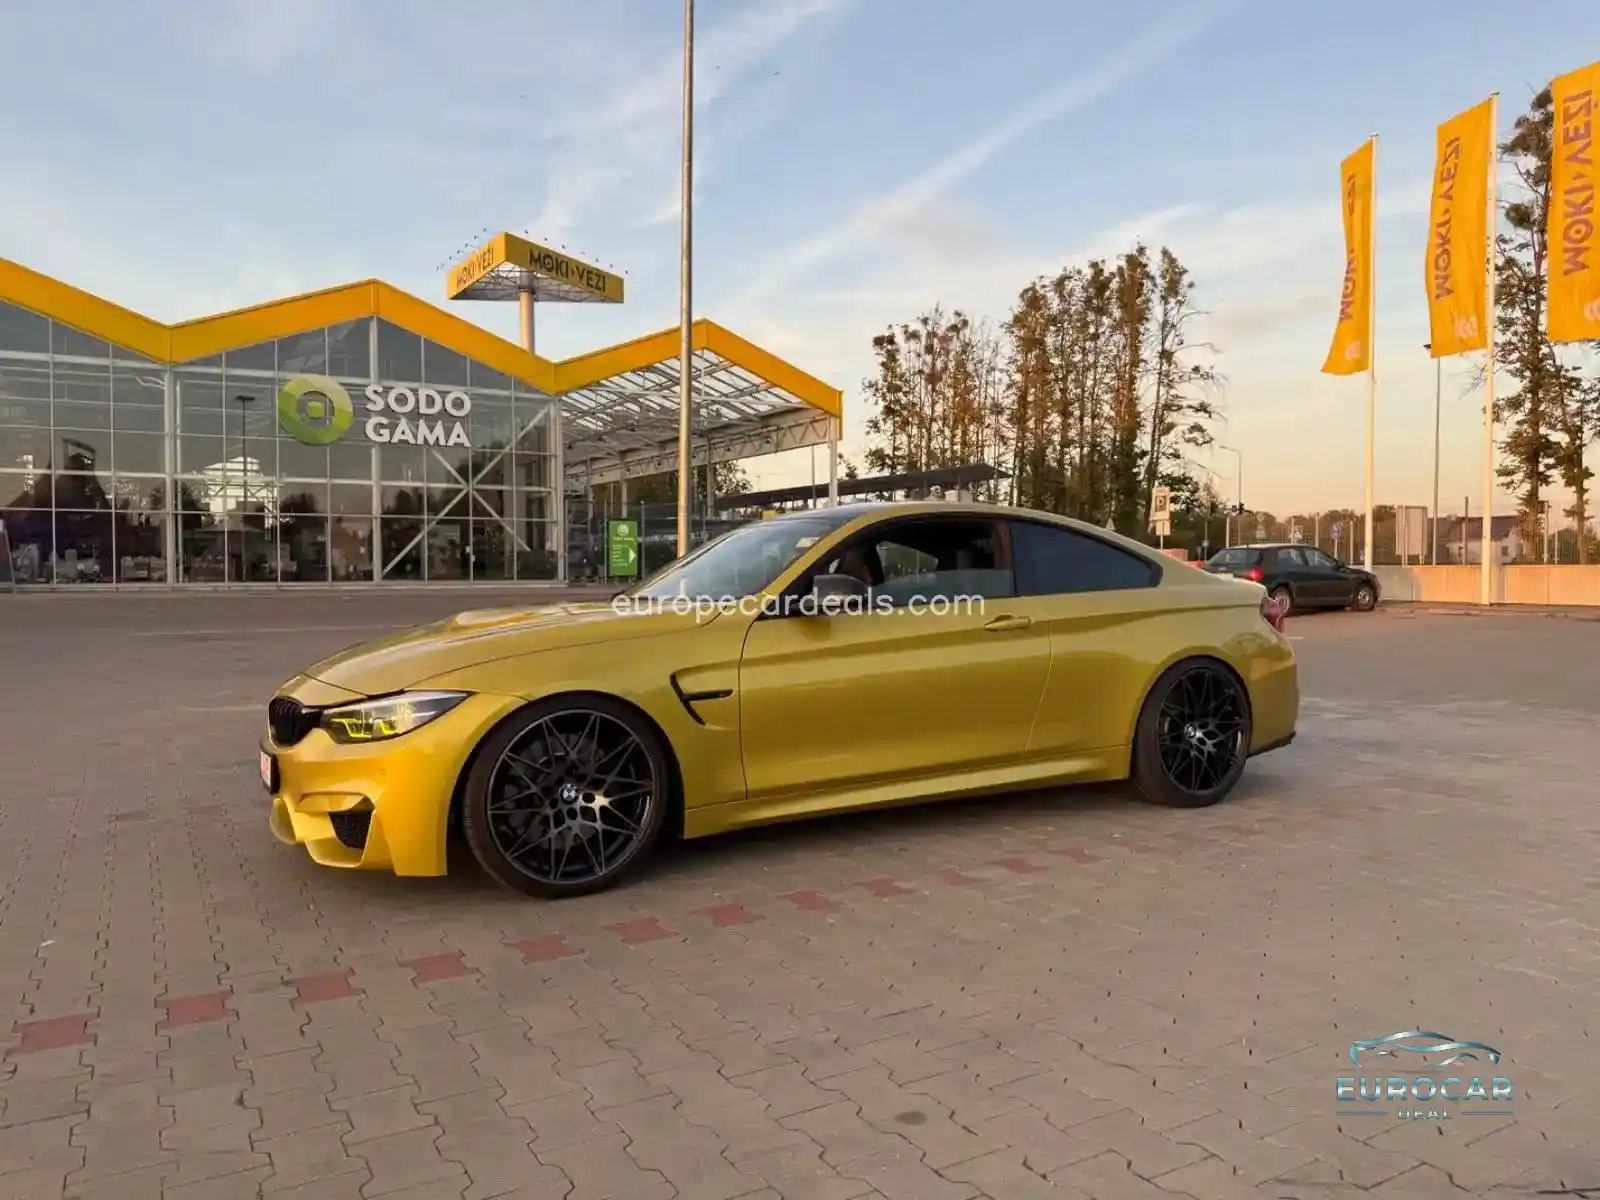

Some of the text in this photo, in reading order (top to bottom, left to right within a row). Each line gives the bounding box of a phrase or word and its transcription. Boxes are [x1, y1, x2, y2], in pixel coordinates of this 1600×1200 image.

[529, 248, 569, 279] MOKI
[364, 383, 472, 417] SODO
[364, 416, 471, 447] GAMA
